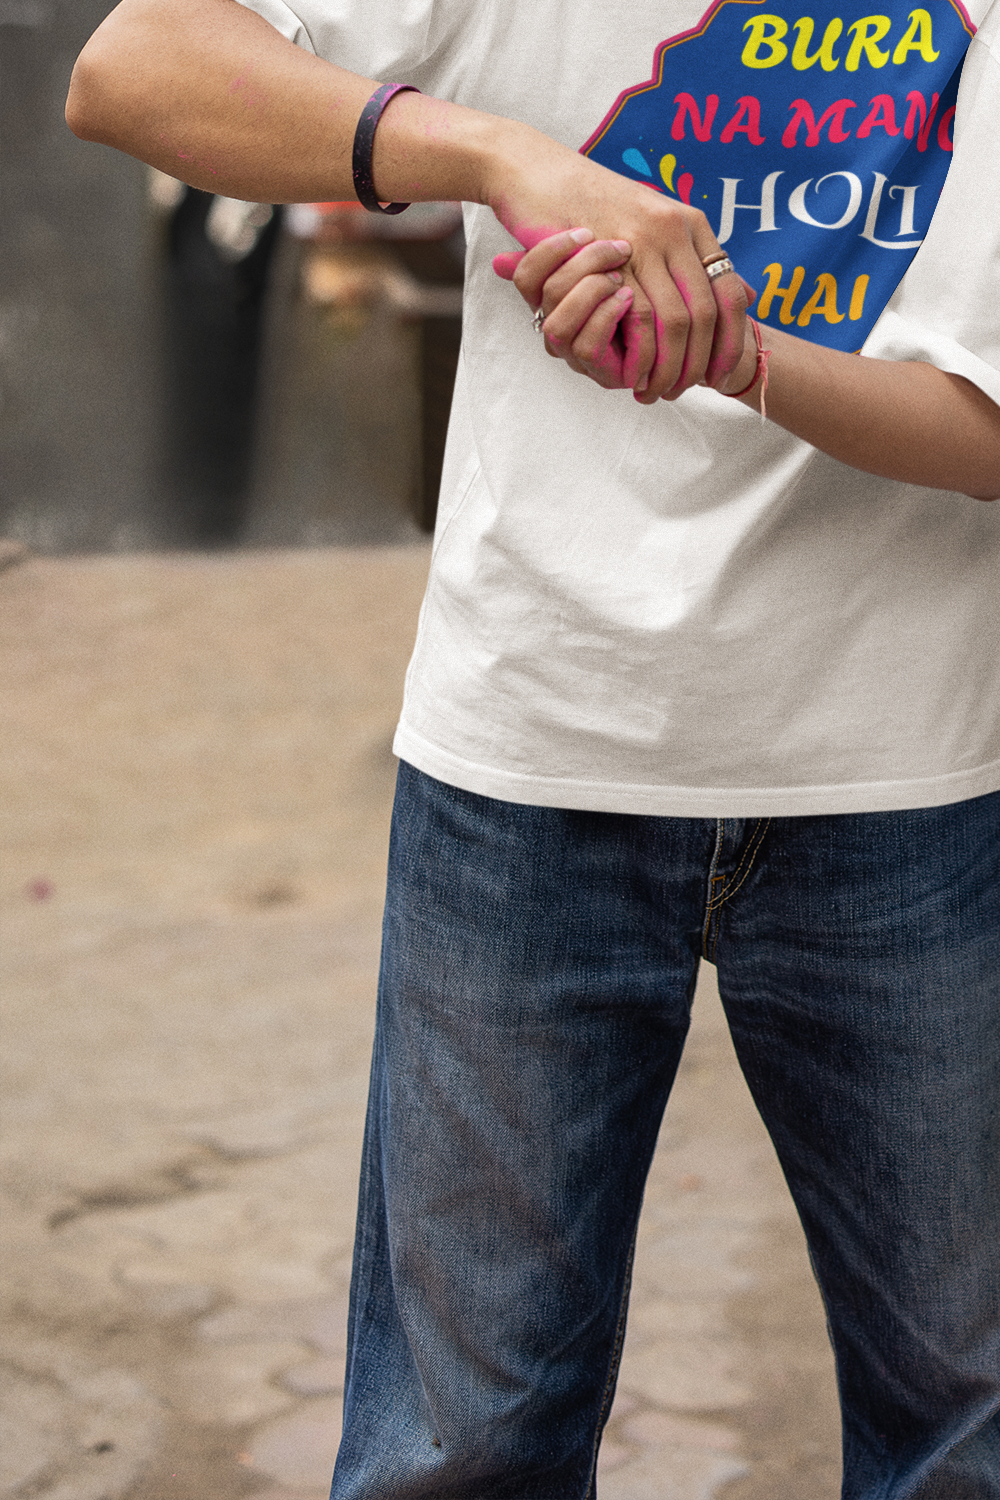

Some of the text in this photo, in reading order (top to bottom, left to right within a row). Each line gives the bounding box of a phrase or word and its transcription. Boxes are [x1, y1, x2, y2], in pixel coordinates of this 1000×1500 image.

[740, 9, 940, 72] BURA
[671, 92, 766, 145] NA
[716, 170, 924, 250] HOLI
[756, 262, 871, 326] HAI
